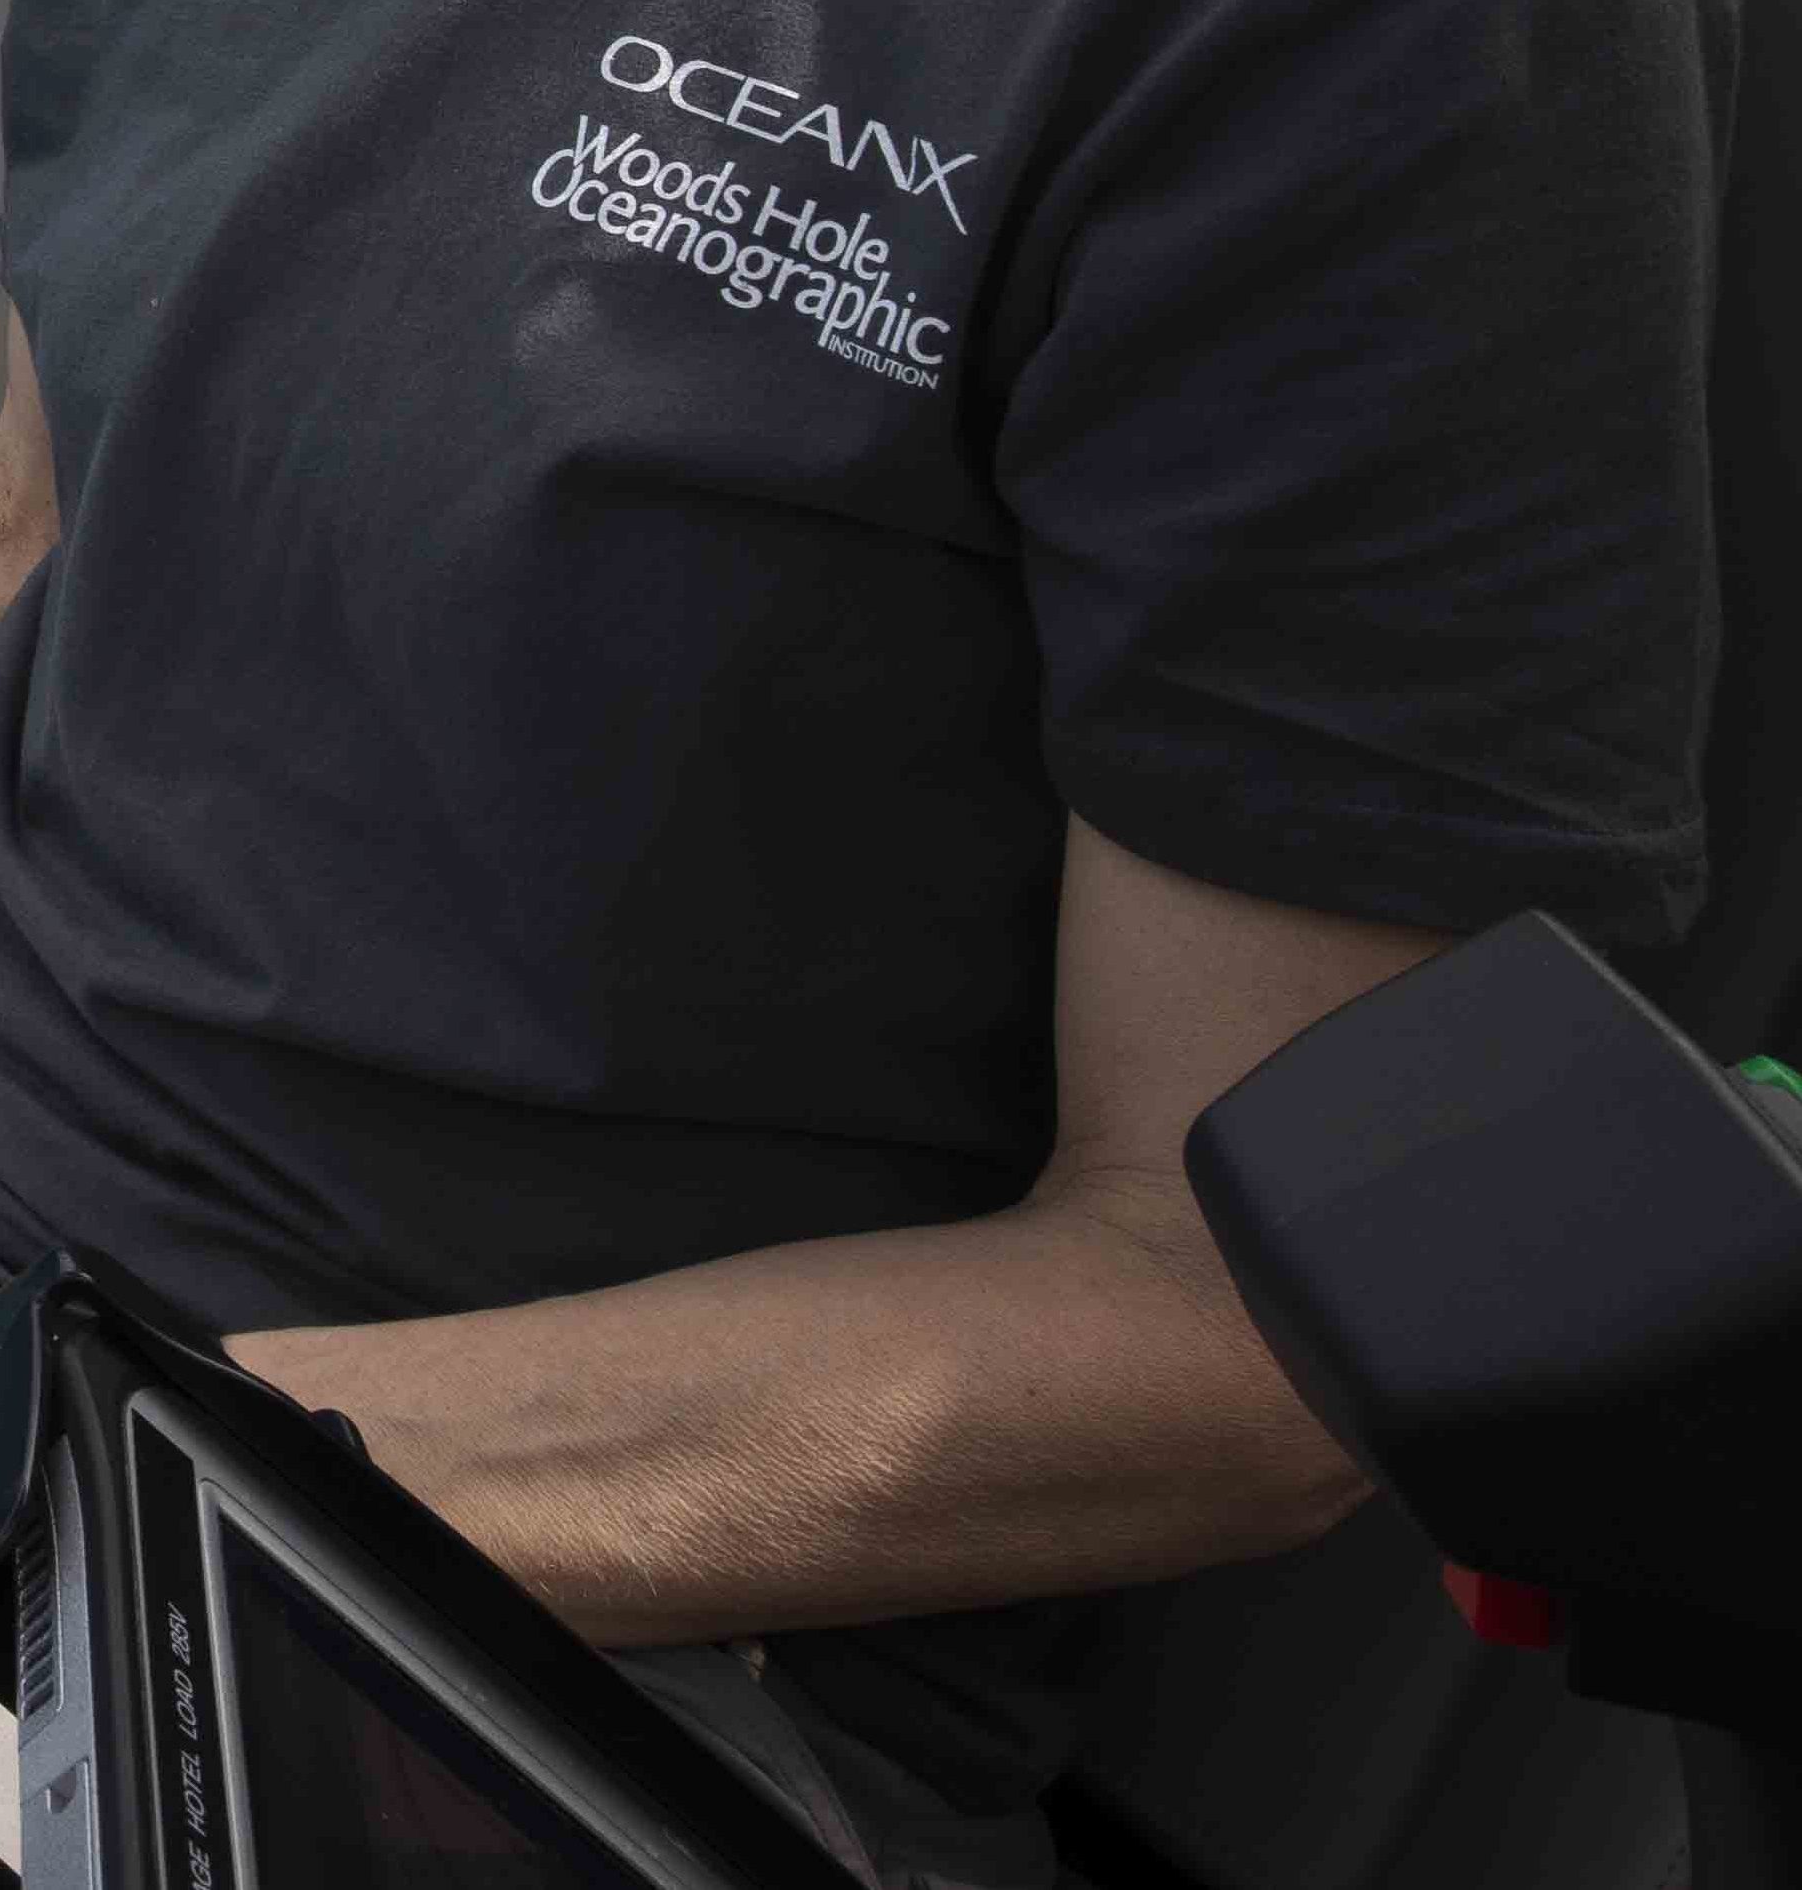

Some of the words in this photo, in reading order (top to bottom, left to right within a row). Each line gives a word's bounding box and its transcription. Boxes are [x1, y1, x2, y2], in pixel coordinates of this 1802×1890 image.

[600, 35, 978, 236] OCEANX
[572, 113, 752, 225] Woods
[753, 185, 890, 278] Hole
[530, 146, 952, 366] Oceanographic
[828, 333, 941, 391] INSTITUTION
[167, 1601, 191, 1665] 285V
[174, 1669, 198, 1740] LOAD
[181, 1750, 207, 1837] HOTEL
